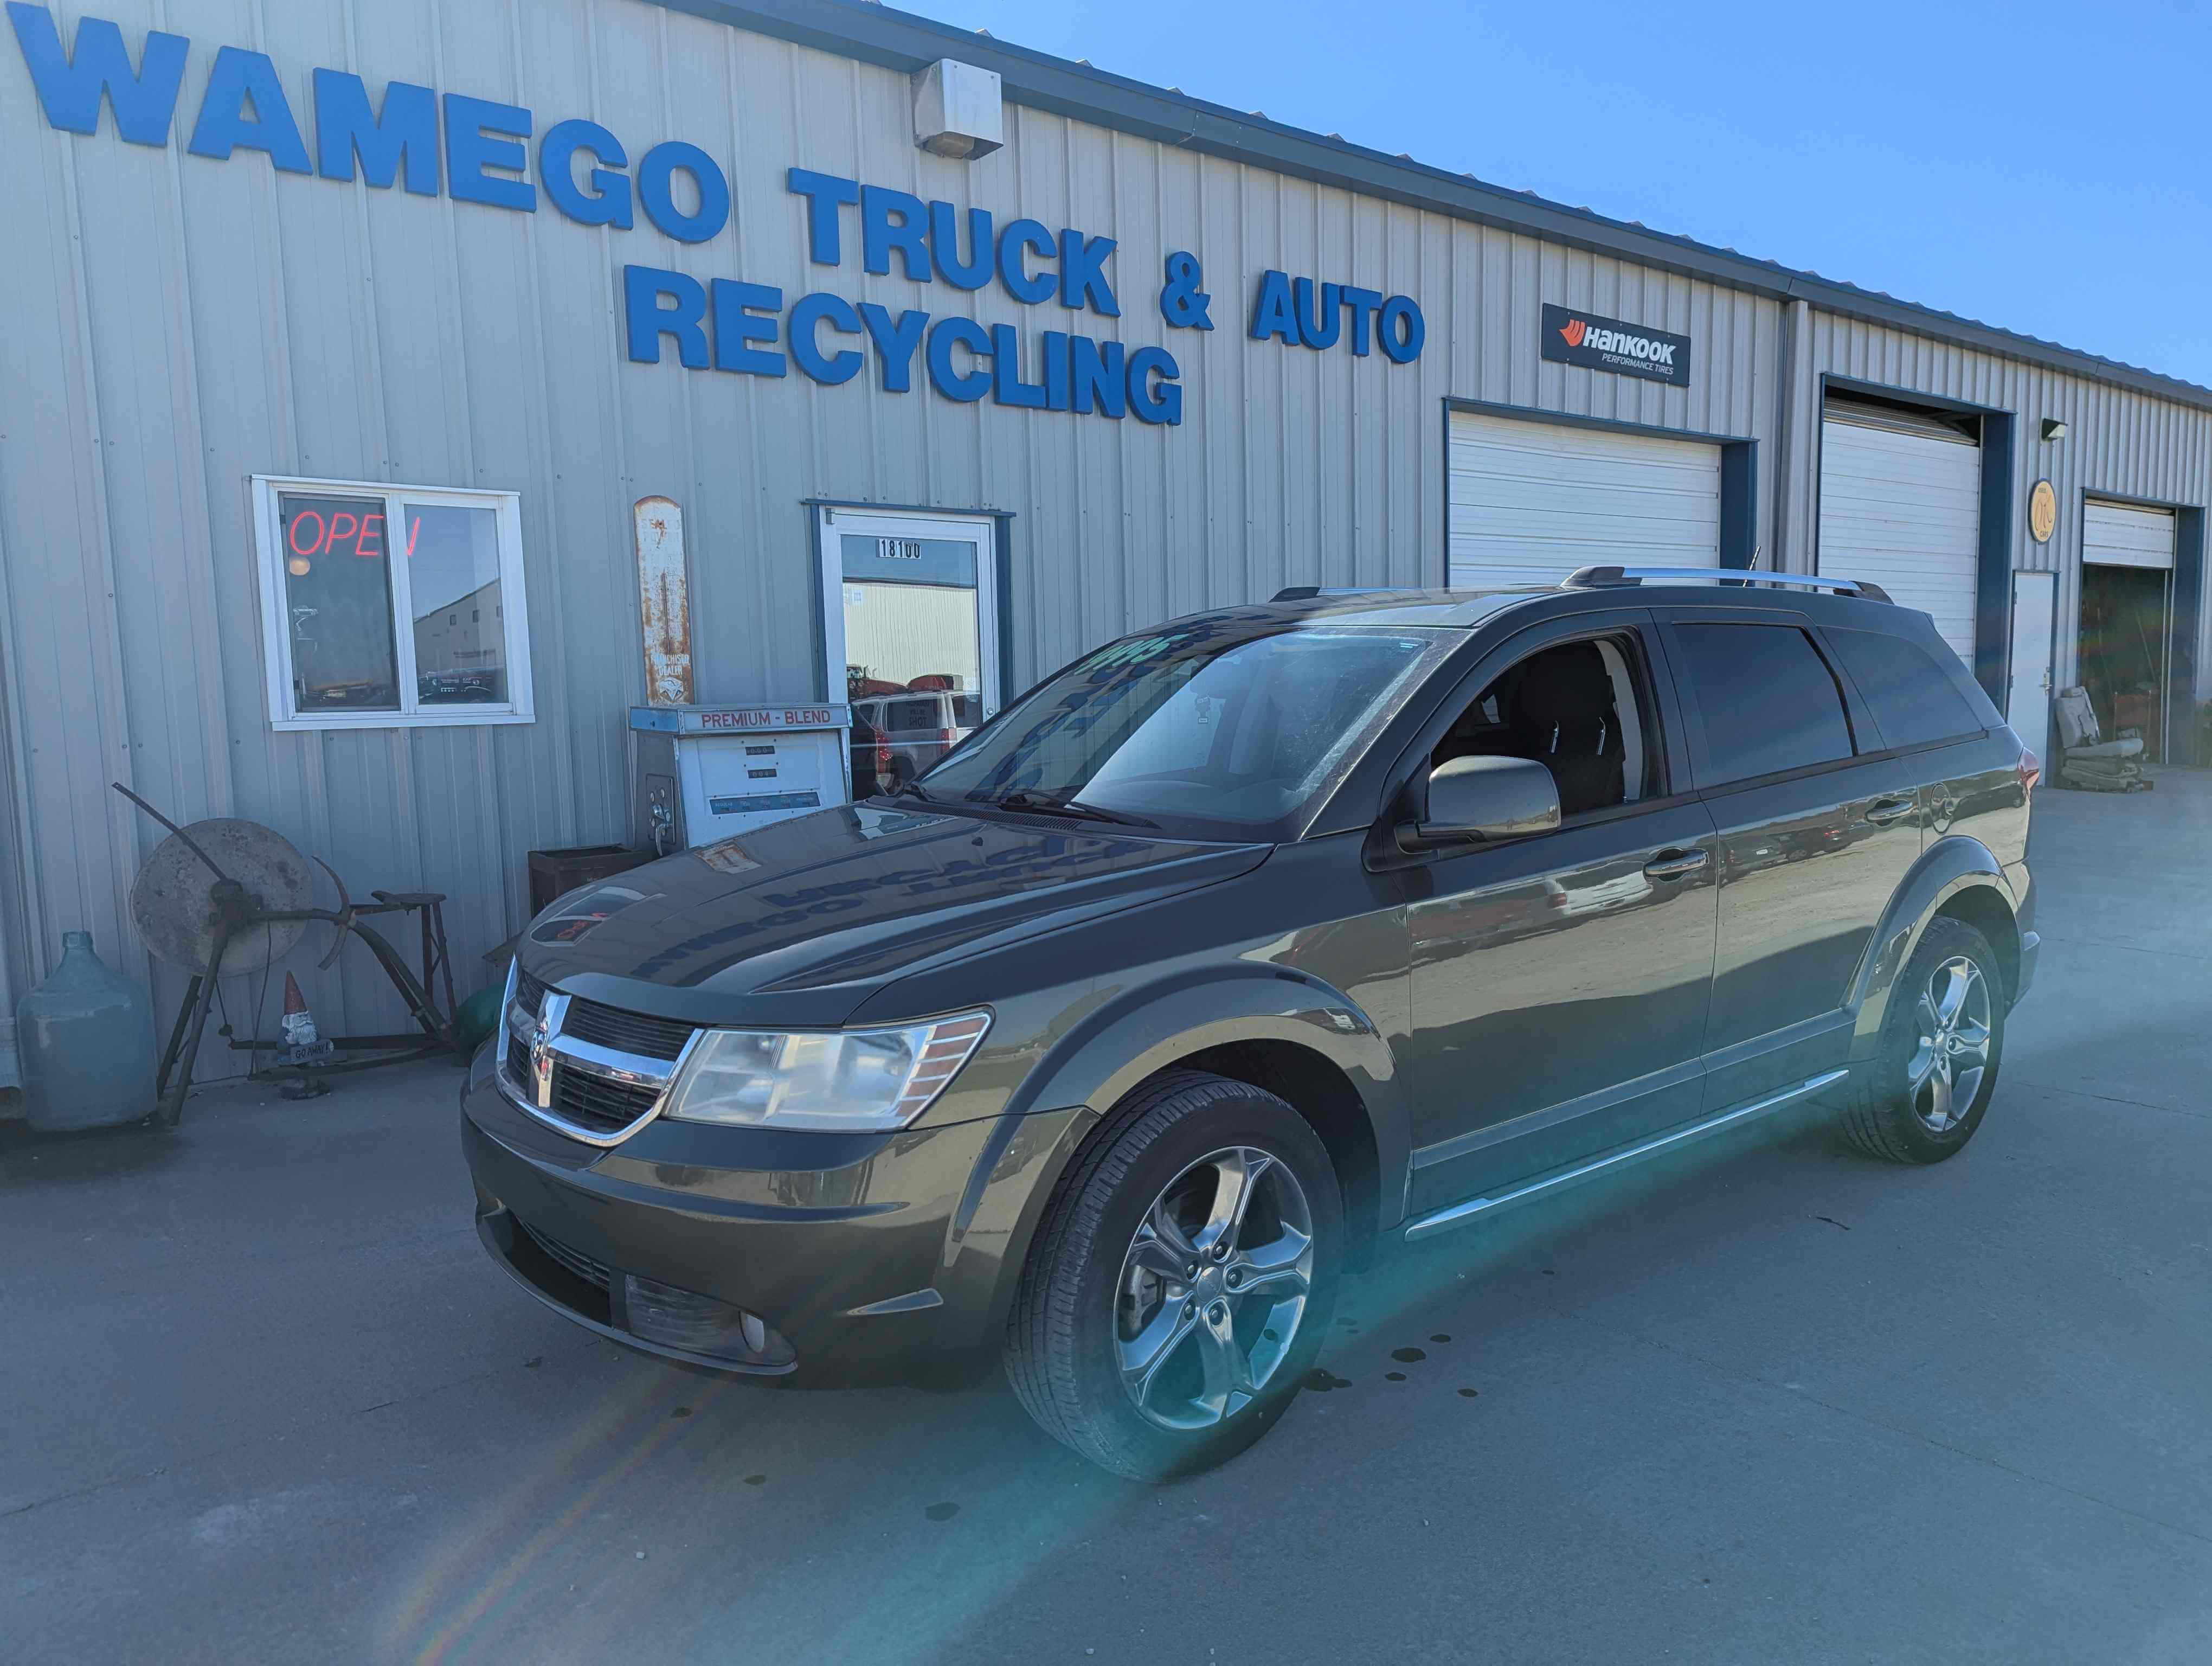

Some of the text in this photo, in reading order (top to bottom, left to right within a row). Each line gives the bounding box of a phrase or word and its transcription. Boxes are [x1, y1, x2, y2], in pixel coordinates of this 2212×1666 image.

[5, 1, 1425, 364] WAMEGO TRUCK & AUTO
[623, 265, 1182, 426] RECYCLING
[1602, 353, 1674, 375] PERFORMANCE TIRES
[882, 539, 921, 559] 18100
[659, 665, 683, 676] DEALER
[702, 711, 771, 728] PREMIUM
[785, 710, 831, 725] BLEND
[909, 716, 928, 727] SHOT
[295, 1042, 329, 1058] GO AWAY!
